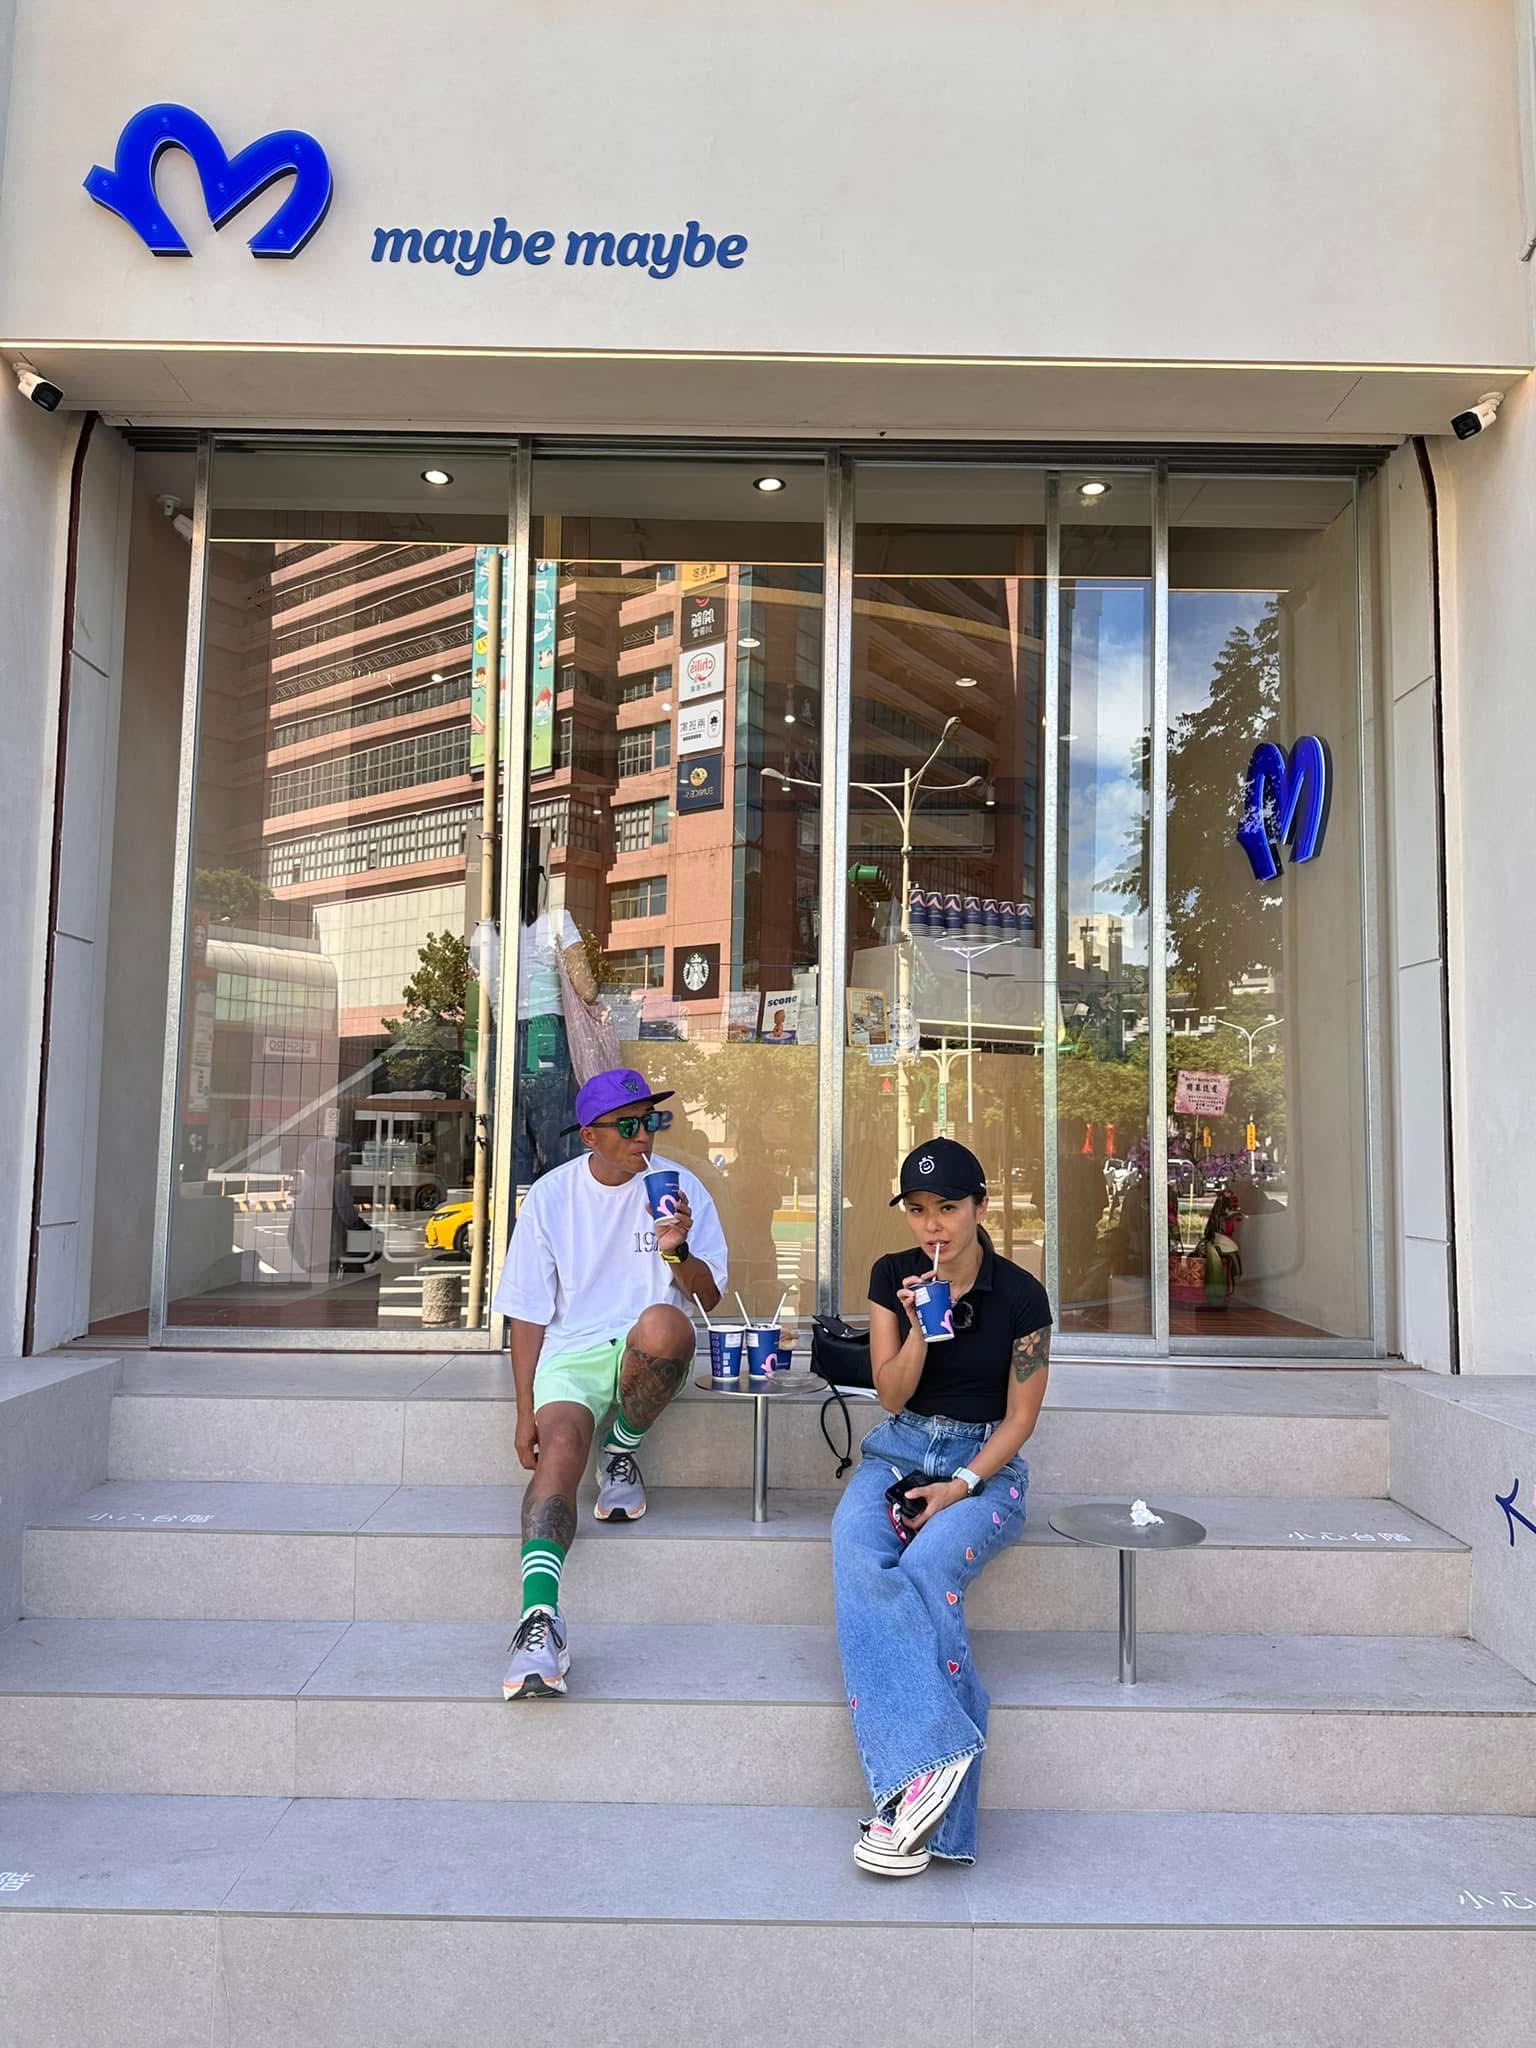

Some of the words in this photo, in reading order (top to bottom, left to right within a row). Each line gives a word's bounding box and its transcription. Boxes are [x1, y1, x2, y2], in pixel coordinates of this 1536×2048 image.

[372, 218, 556, 277] maybe
[566, 222, 749, 280] maybe
[767, 995, 798, 1007] scone
